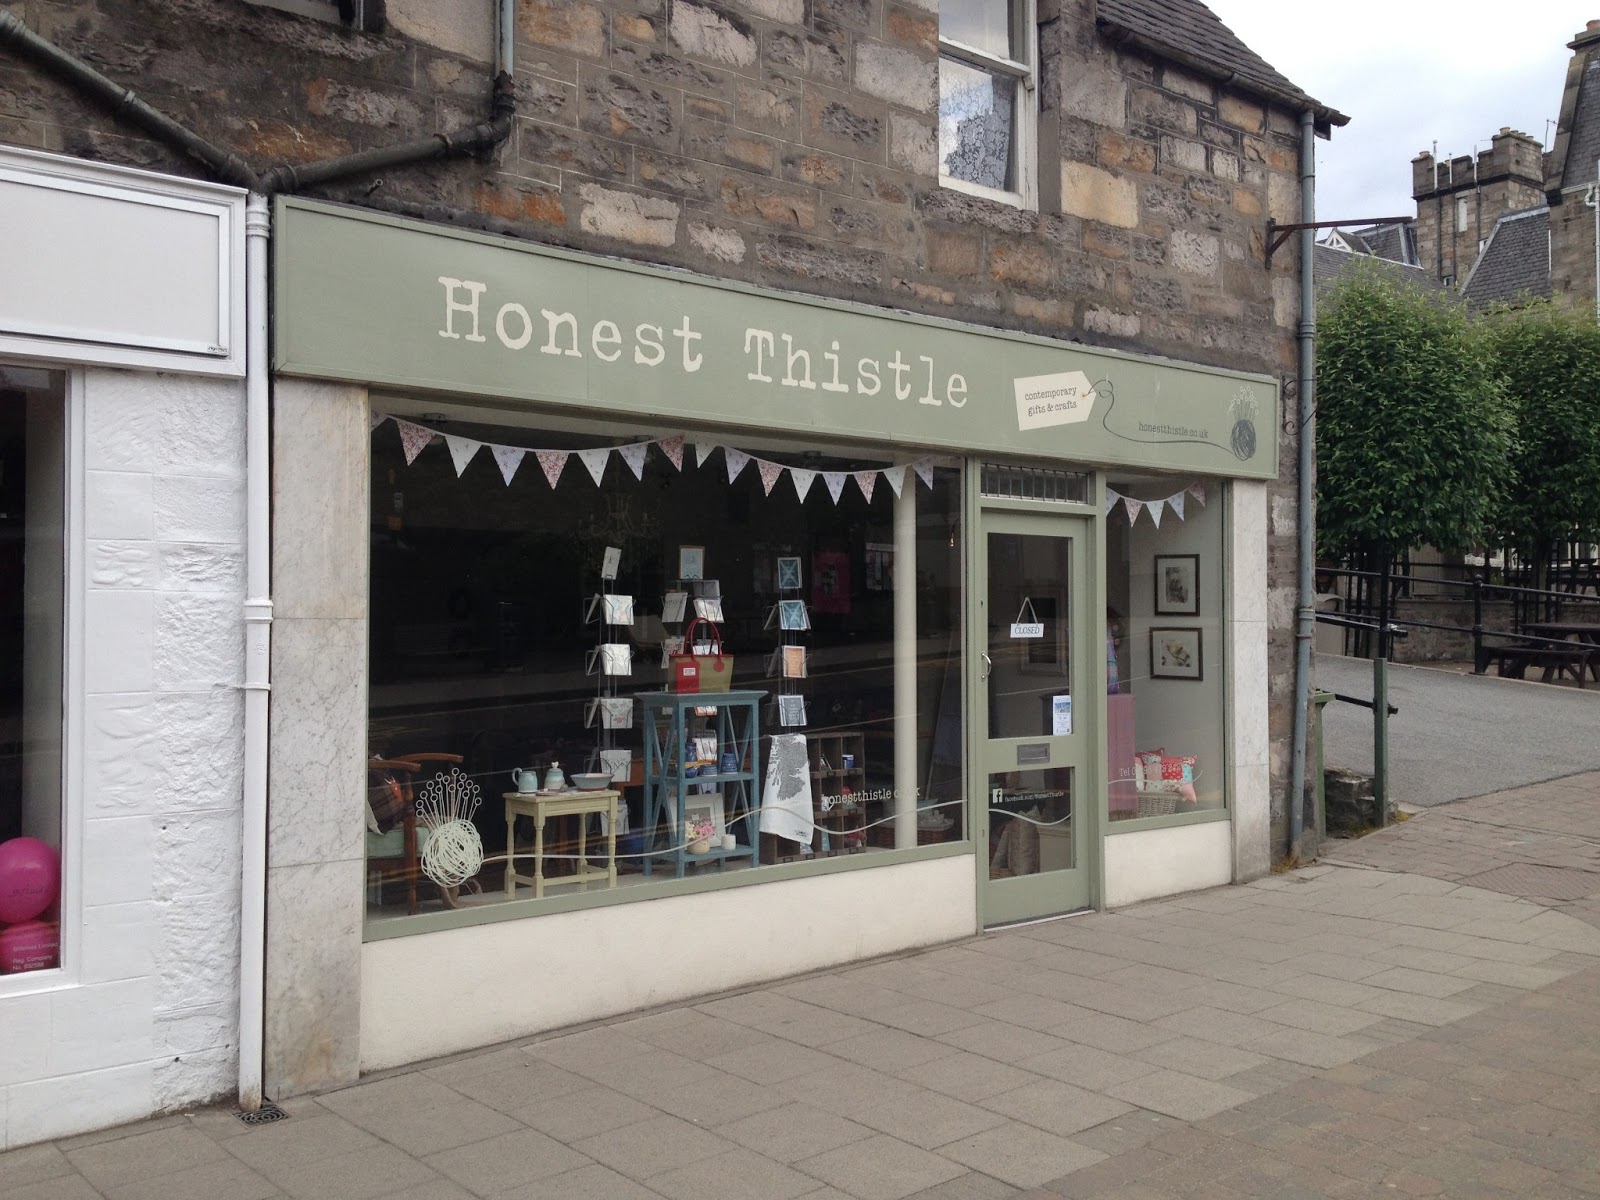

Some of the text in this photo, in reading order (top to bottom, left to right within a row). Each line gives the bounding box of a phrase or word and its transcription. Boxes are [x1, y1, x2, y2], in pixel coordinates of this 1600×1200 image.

[438, 276, 968, 408] Honest Thistle
[1024, 387, 1077, 401] contemporary
[1028, 401, 1078, 417] gifts & crafts
[1138, 421, 1209, 439] honestthistle.co.uk
[1014, 626, 1040, 635] CLOSED
[1120, 767, 1130, 777] Tel
